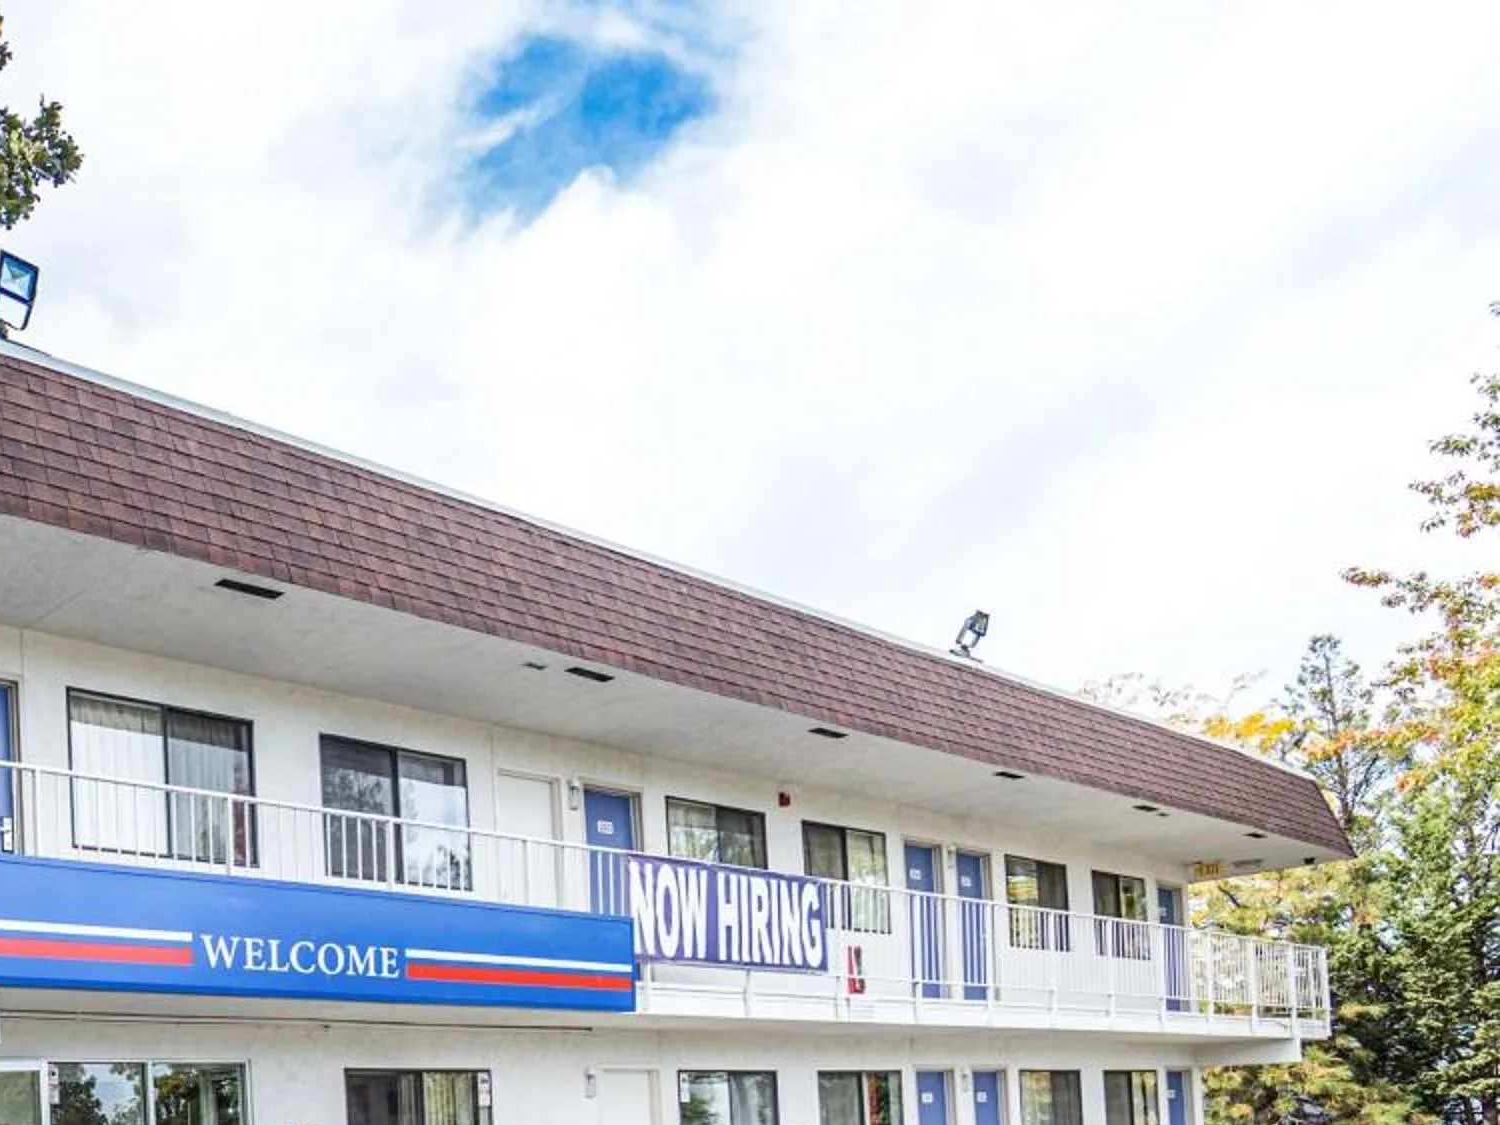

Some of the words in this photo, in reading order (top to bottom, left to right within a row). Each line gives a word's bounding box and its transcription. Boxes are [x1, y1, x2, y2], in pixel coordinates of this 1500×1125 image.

[628, 855, 708, 959] NOW
[717, 871, 823, 968] HIRING
[200, 933, 401, 979] WELCOME
